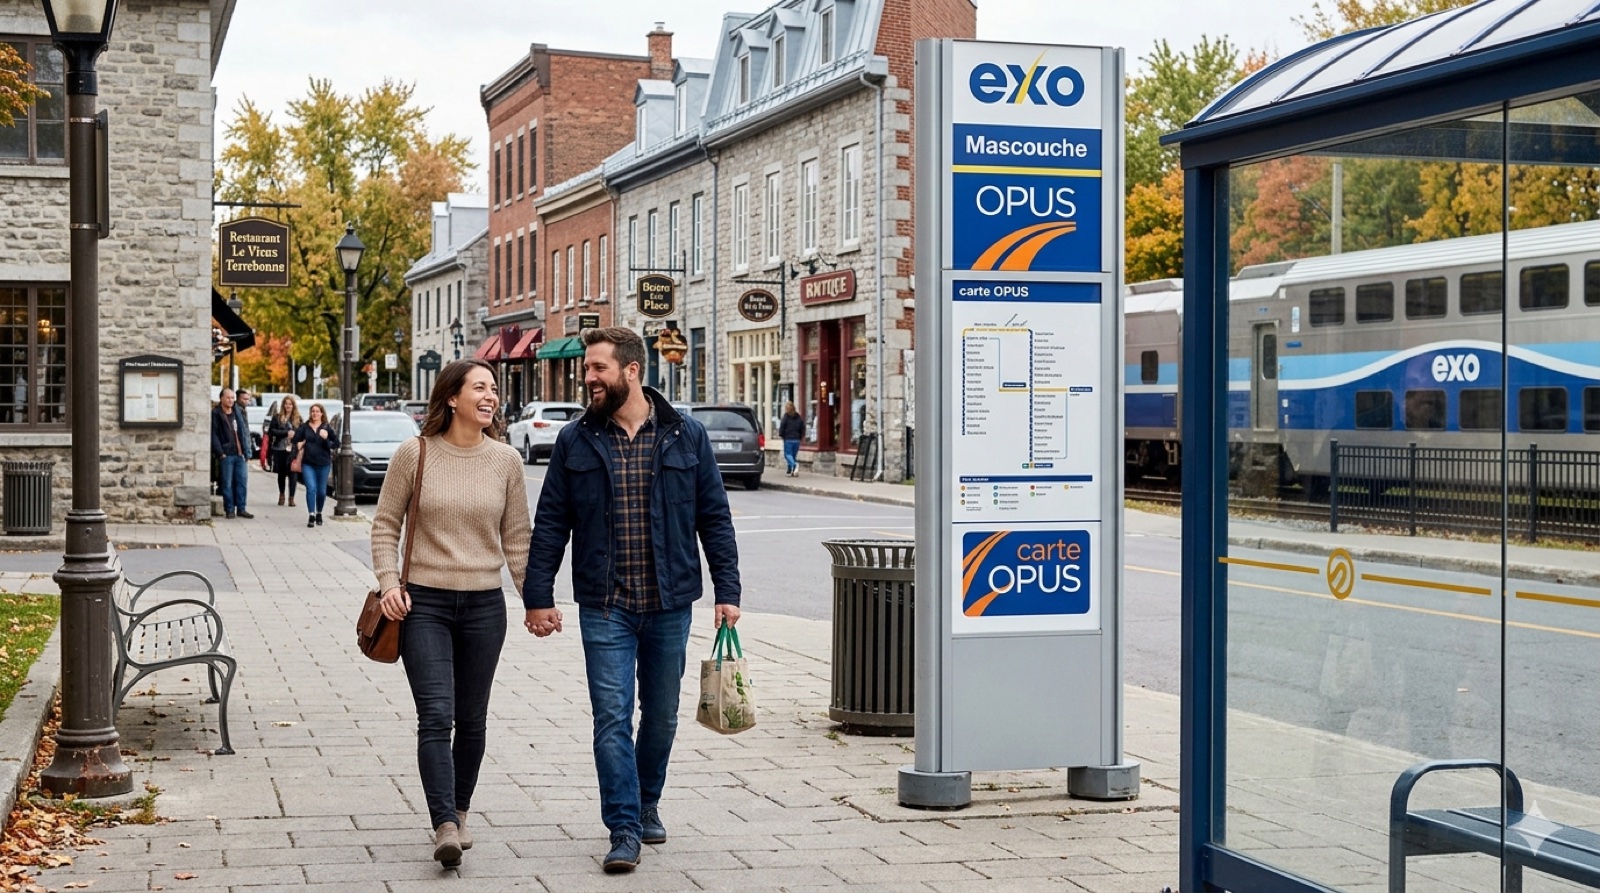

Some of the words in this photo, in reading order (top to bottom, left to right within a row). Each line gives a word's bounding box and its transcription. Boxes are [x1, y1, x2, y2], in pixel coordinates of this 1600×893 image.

[969, 47, 1085, 107] exo
[965, 134, 1088, 158] Mascouche
[976, 185, 1077, 218] OPUS
[229, 230, 281, 243] Restaurant
[959, 287, 991, 297] carte
[993, 286, 1029, 298] OPUS
[1431, 353, 1480, 382] exo
[1017, 538, 1081, 561] carte
[988, 563, 1081, 594] OPUS
